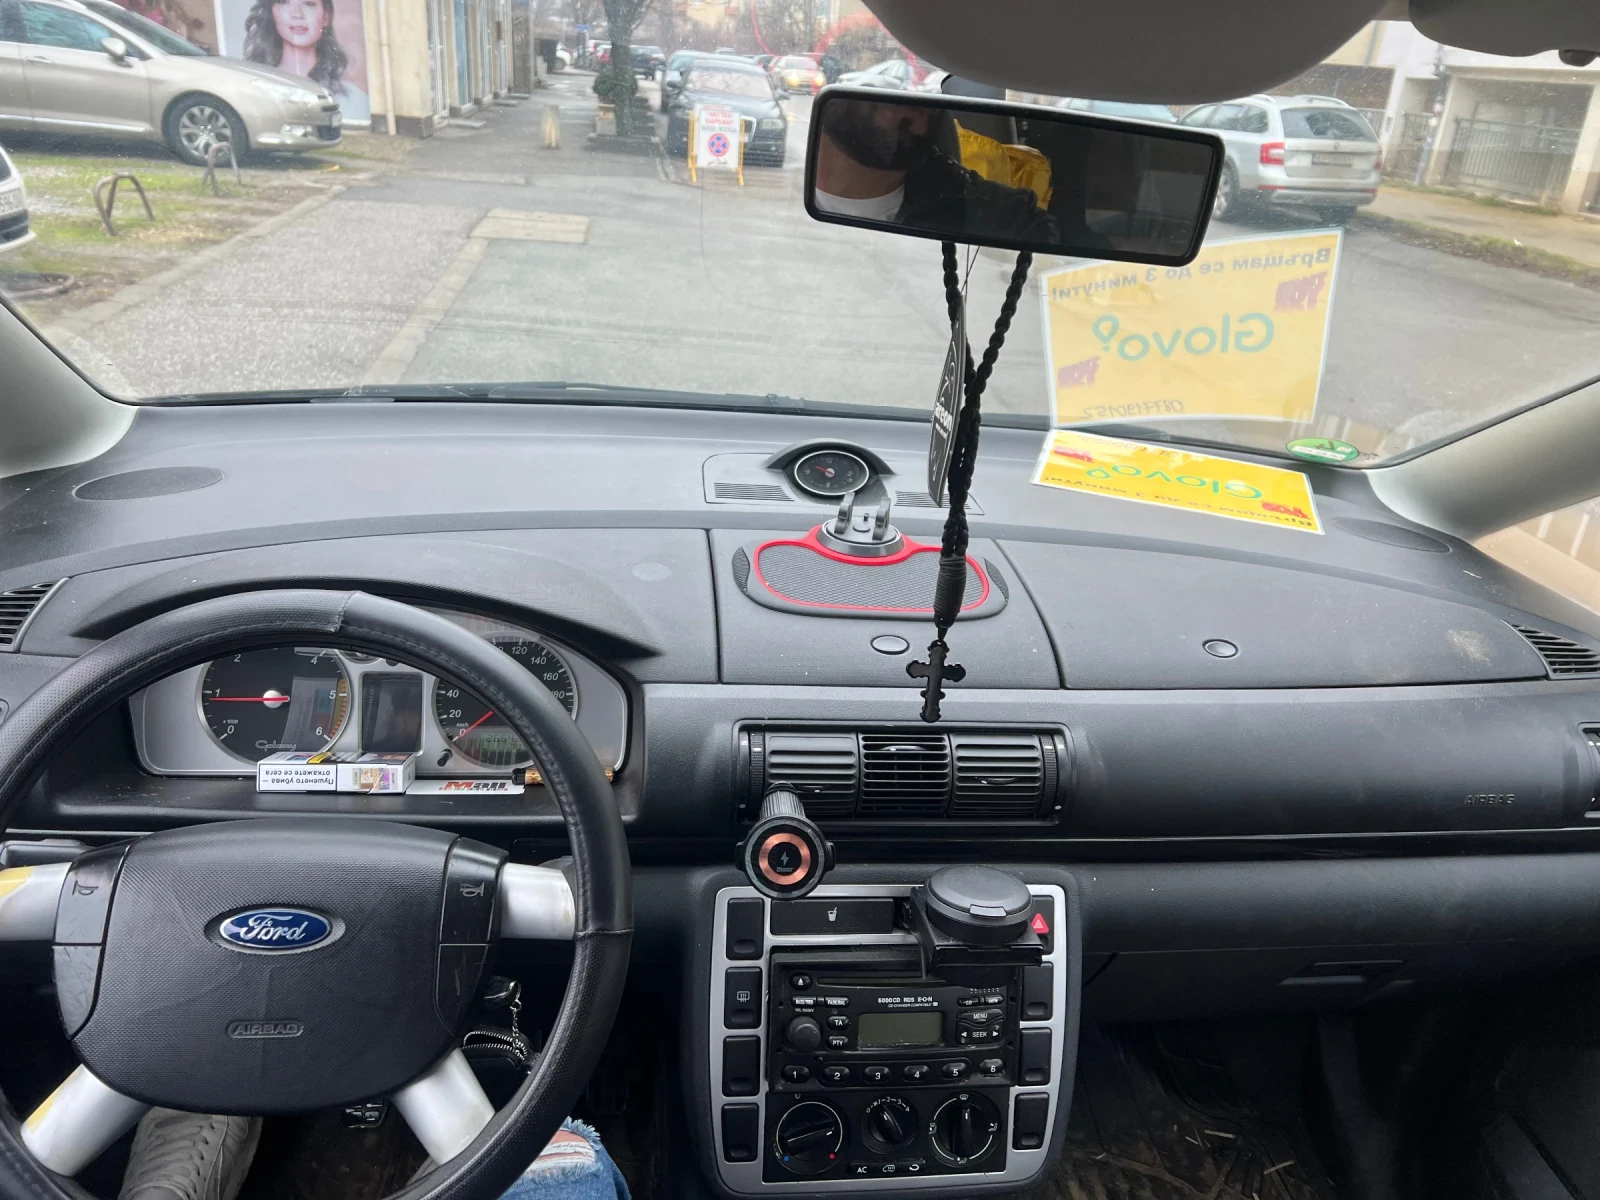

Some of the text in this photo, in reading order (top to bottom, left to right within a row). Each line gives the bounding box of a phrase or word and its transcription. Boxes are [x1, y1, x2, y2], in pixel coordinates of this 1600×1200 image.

[511, 646, 528, 655] 120
[233, 654, 241, 662] 2
[310, 656, 318, 665] 4
[530, 656, 547, 665] 140
[543, 672, 559, 681] 160
[215, 688, 221, 697] 1
[329, 690, 336, 700] 5
[446, 689, 459, 698] 40
[449, 709, 462, 718] 20
[227, 725, 235, 734] 0
[315, 727, 322, 736] 6
[240, 914, 309, 941] Ford
[234, 1023, 298, 1035] AIRBAG
[990, 1065, 996, 1073] 6
[834, 1072, 840, 1080] 2
[875, 1072, 881, 1080] 3
[914, 1071, 920, 1079] 4
